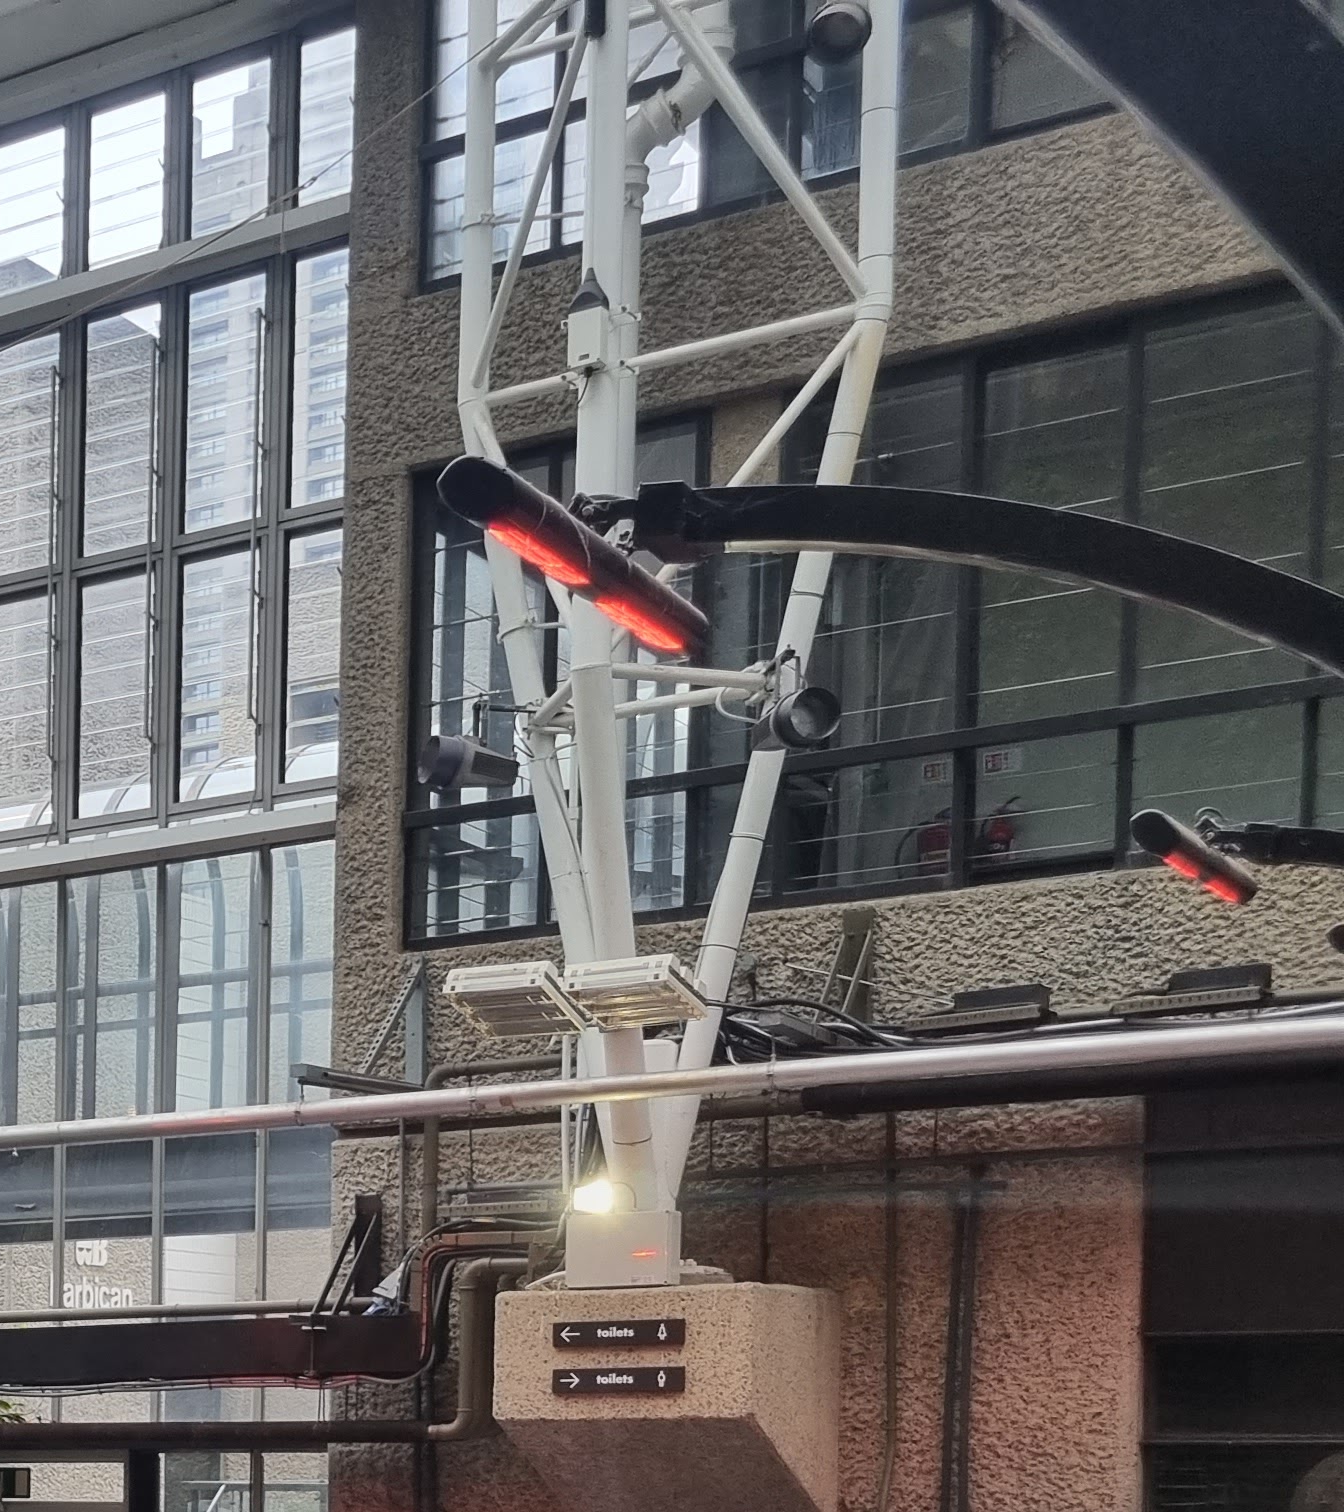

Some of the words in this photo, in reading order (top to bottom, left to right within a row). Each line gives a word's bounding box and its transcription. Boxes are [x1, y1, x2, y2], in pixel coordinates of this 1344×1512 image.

[50, 1271, 132, 1308] arbican
[596, 1327, 635, 1338] toilets
[596, 1373, 634, 1384] toilets
